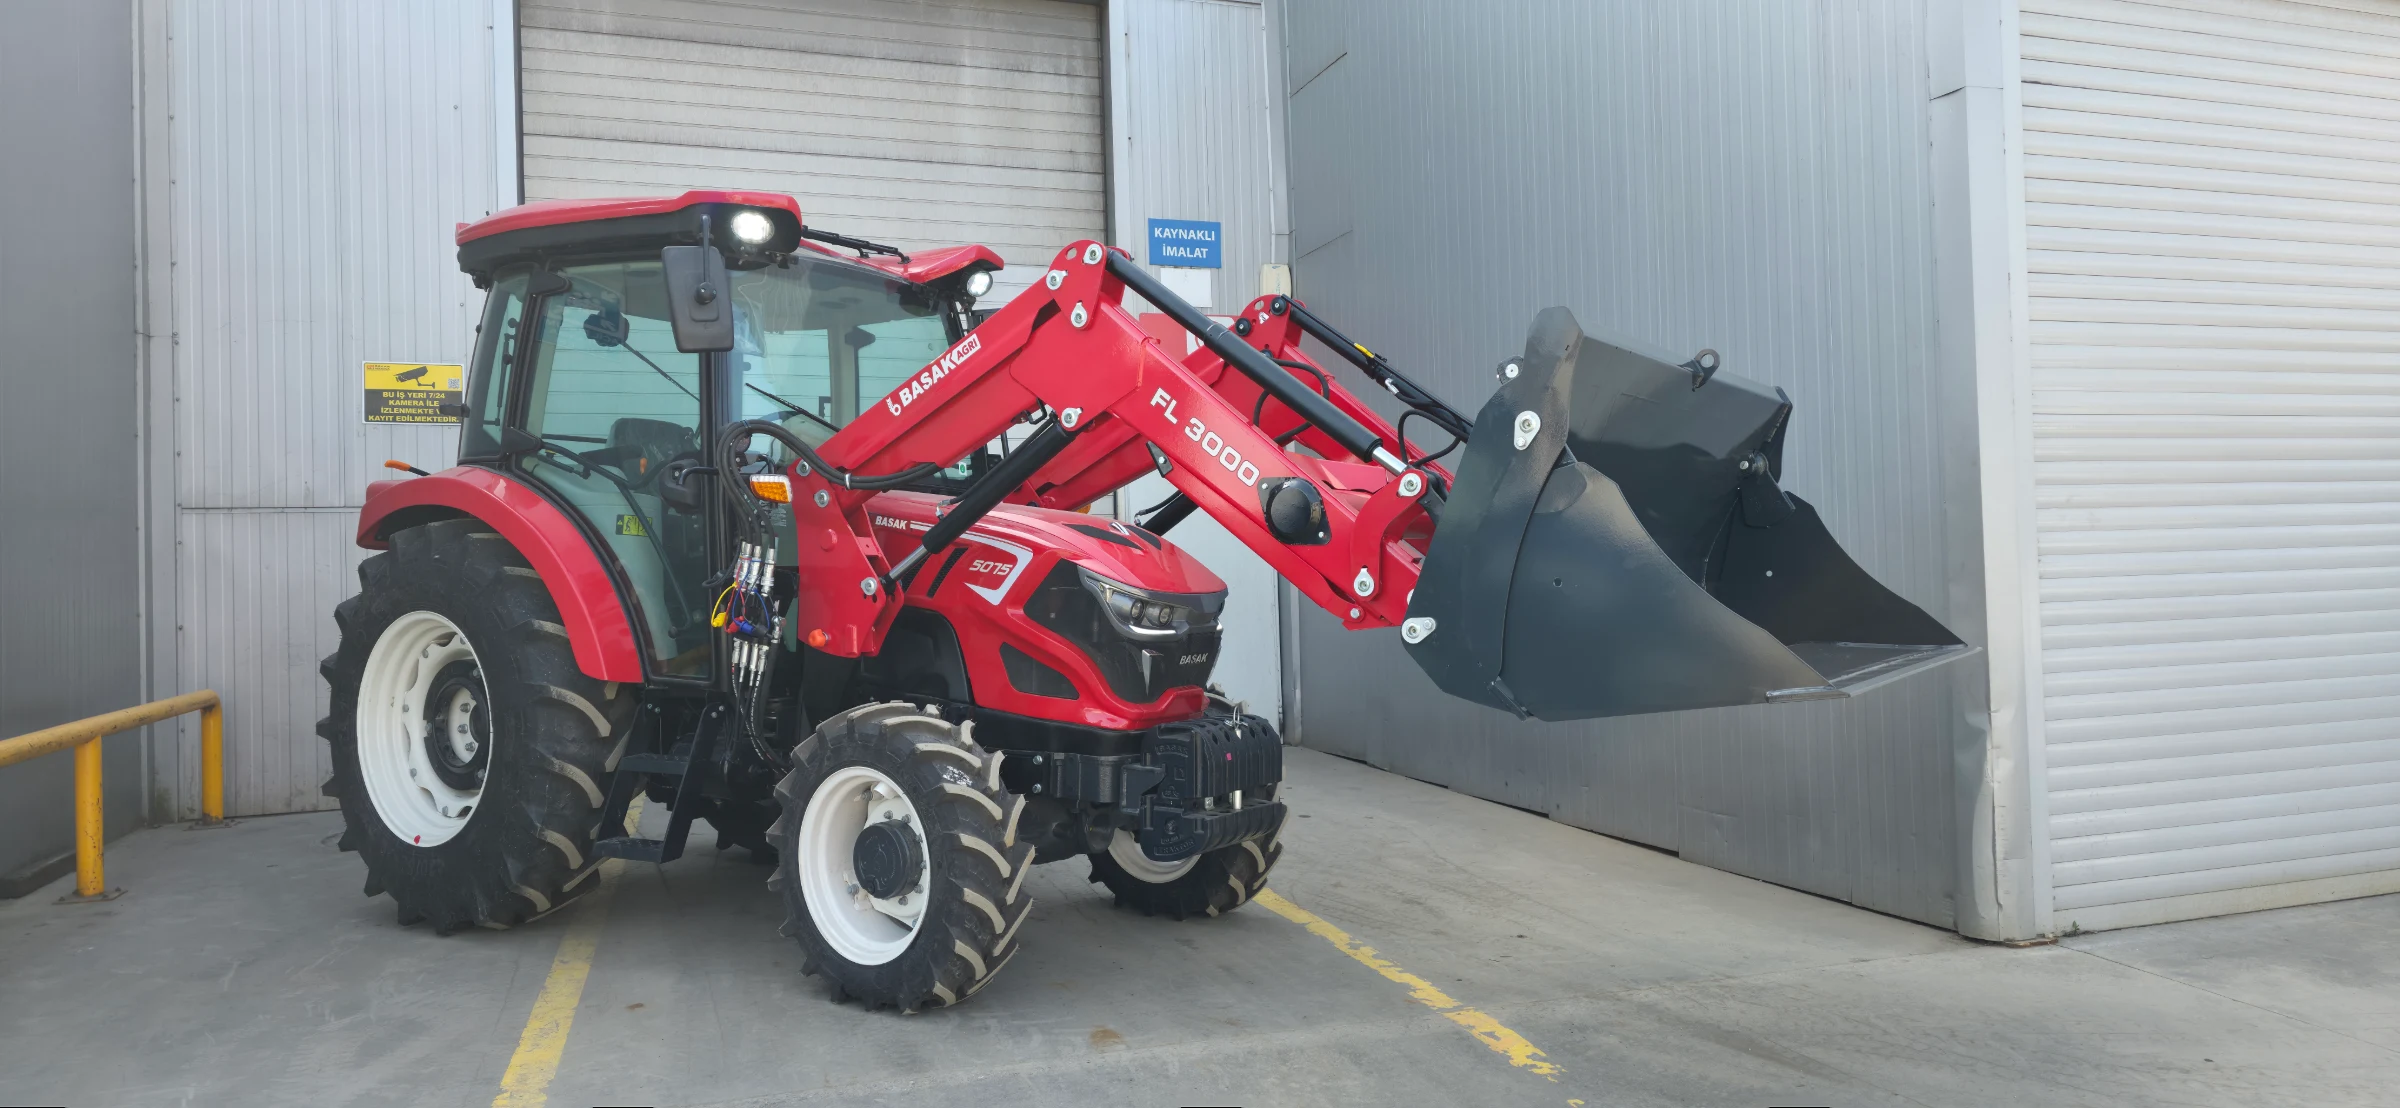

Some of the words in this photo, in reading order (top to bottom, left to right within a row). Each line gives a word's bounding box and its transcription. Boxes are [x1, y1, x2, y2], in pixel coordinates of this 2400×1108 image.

[1154, 227, 1215, 241] KAYNAKLI
[1162, 243, 1209, 259] İMALAT
[898, 352, 957, 407] BASAK
[956, 338, 978, 360] AGRI
[396, 391, 405, 399] İŞ
[381, 406, 434, 414] İZLENMEKTE
[395, 415, 459, 423] EDİLMEKTEDİR.
[1150, 387, 1178, 424] FL
[1184, 417, 1260, 487] 3000
[875, 515, 908, 530] BASAK
[969, 559, 1013, 576] 5075
[1179, 652, 1209, 665] BASAK
